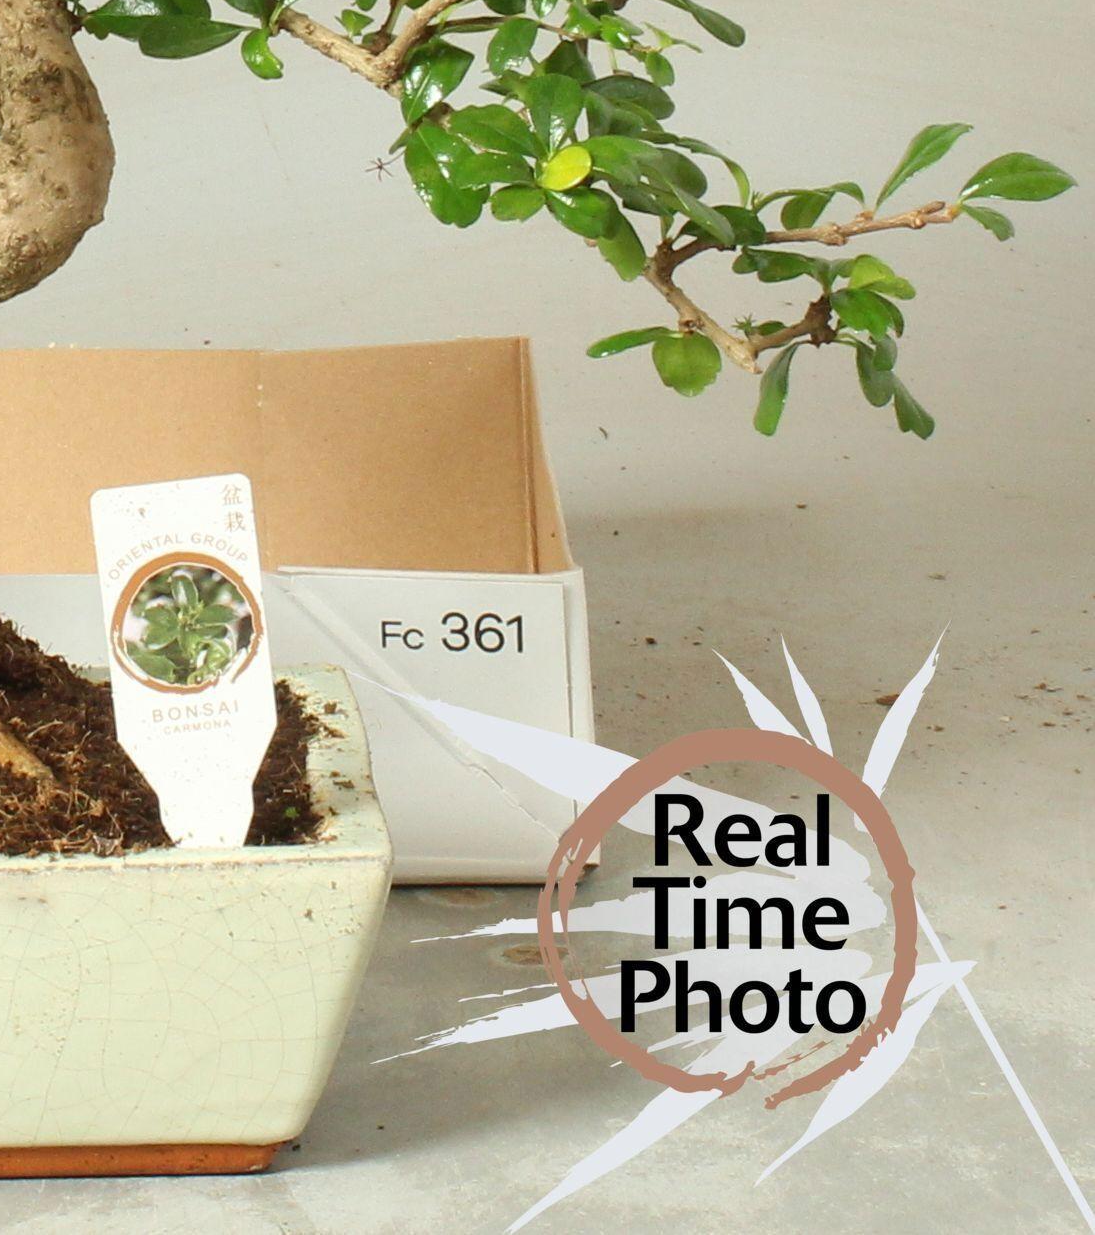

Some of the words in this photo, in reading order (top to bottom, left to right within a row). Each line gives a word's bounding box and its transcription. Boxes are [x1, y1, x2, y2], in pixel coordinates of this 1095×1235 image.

[223, 484, 246, 532] 盆栽
[108, 533, 183, 580] ORIENTAL
[191, 533, 248, 562] GROUP
[381, 620, 424, 650] Fc
[441, 611, 524, 653] 361
[152, 701, 239, 722] BONSAI
[164, 720, 231, 734] CARMONA
